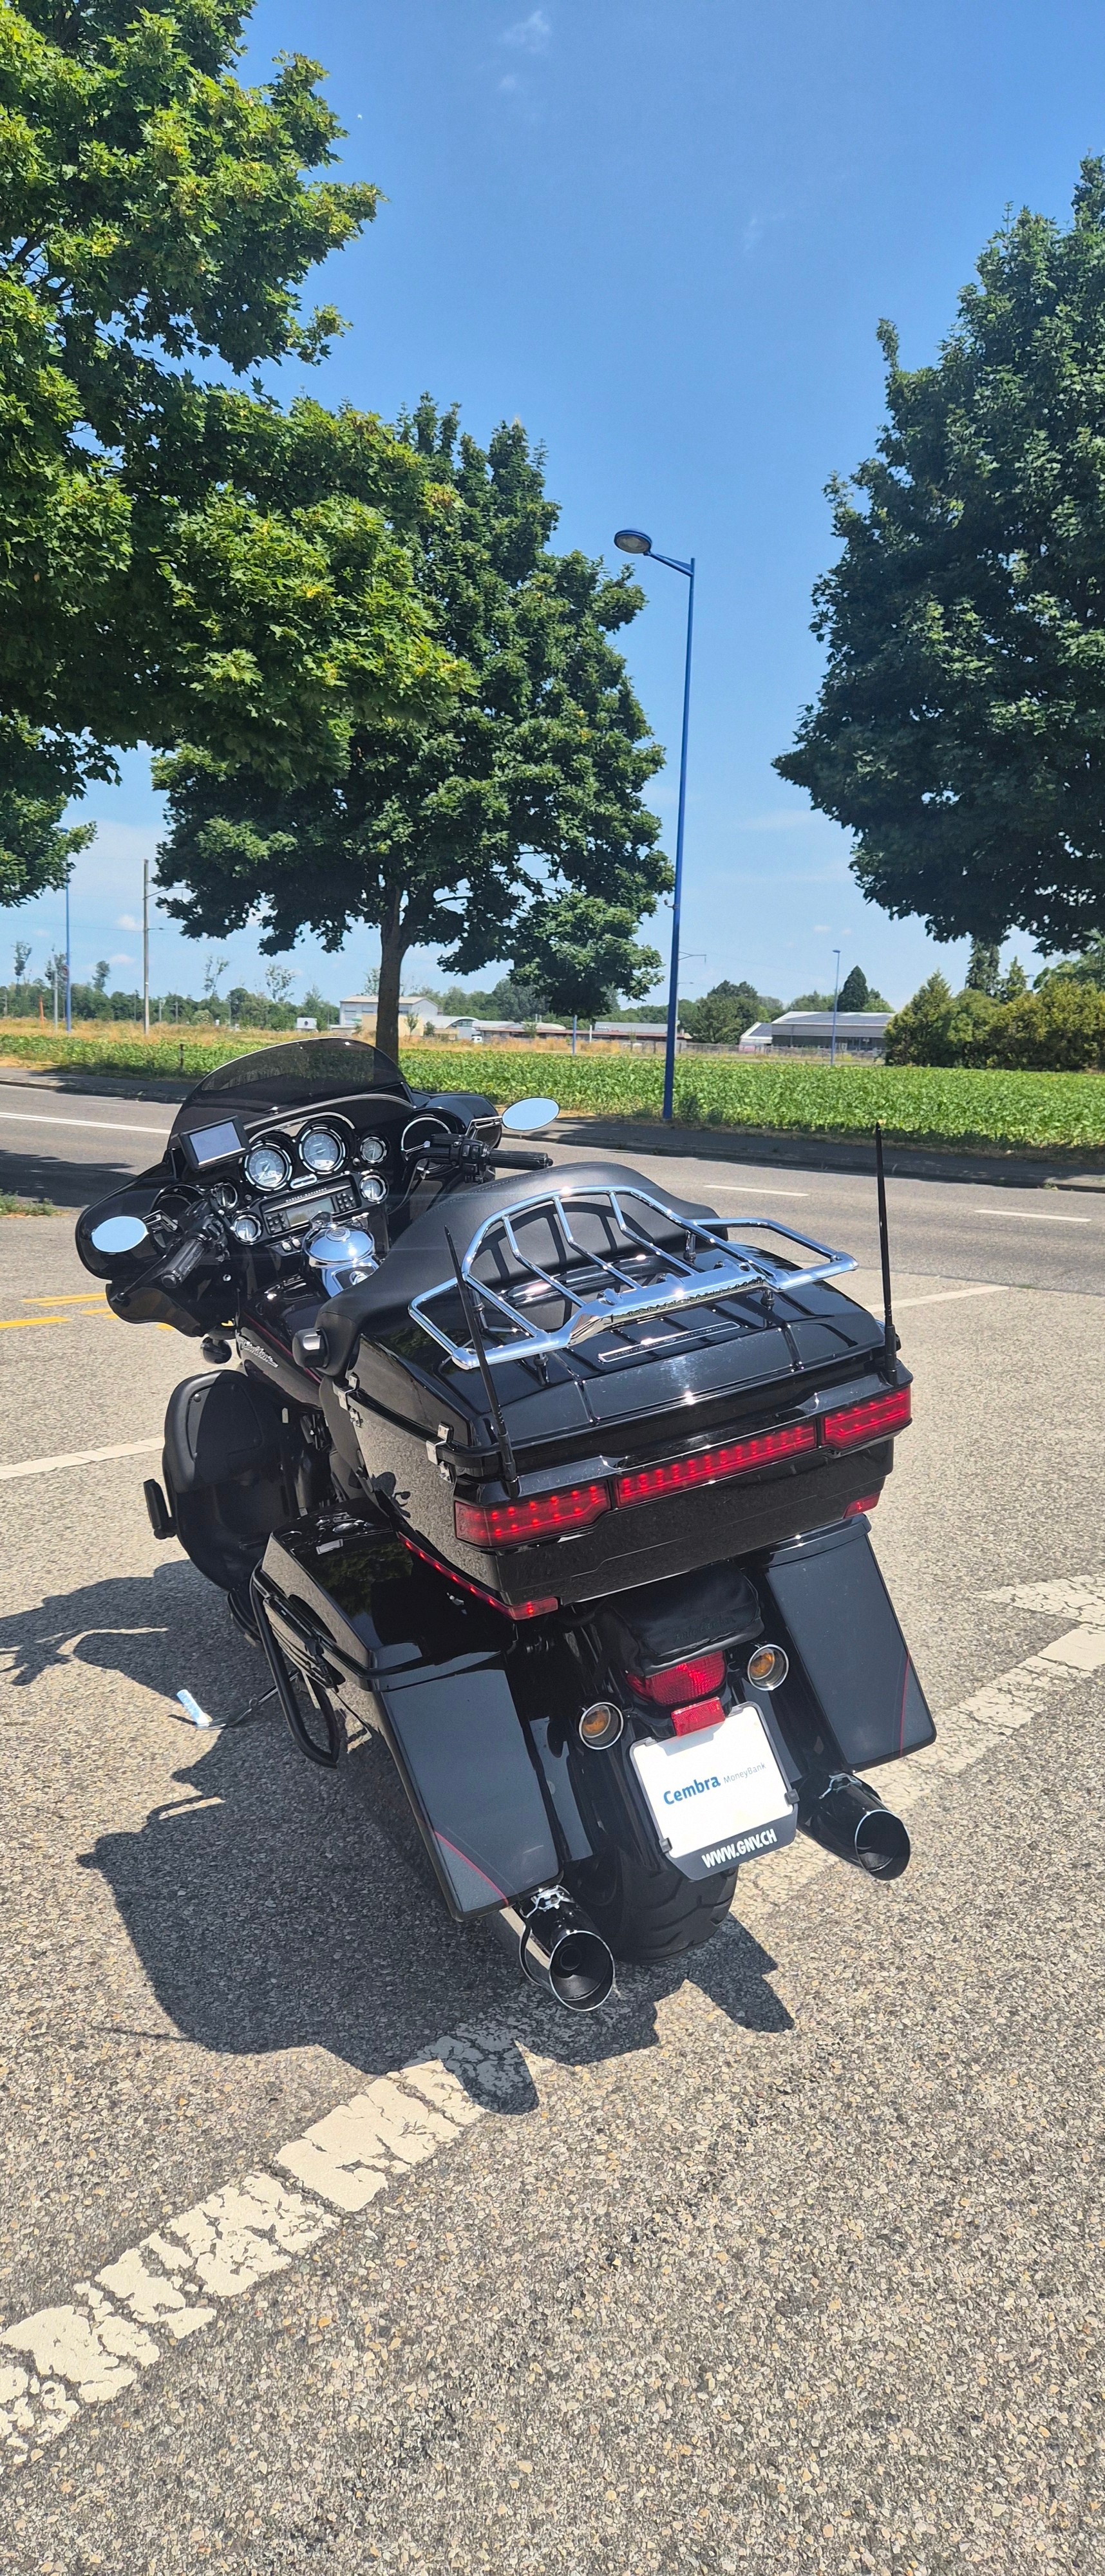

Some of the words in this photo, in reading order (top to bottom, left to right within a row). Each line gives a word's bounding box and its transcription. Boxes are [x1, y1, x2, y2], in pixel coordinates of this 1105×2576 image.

[663, 1776, 721, 1805] Cembra
[723, 1763, 766, 1785] MoneyBank
[701, 1828, 777, 1868] WWW.GNV.CH
